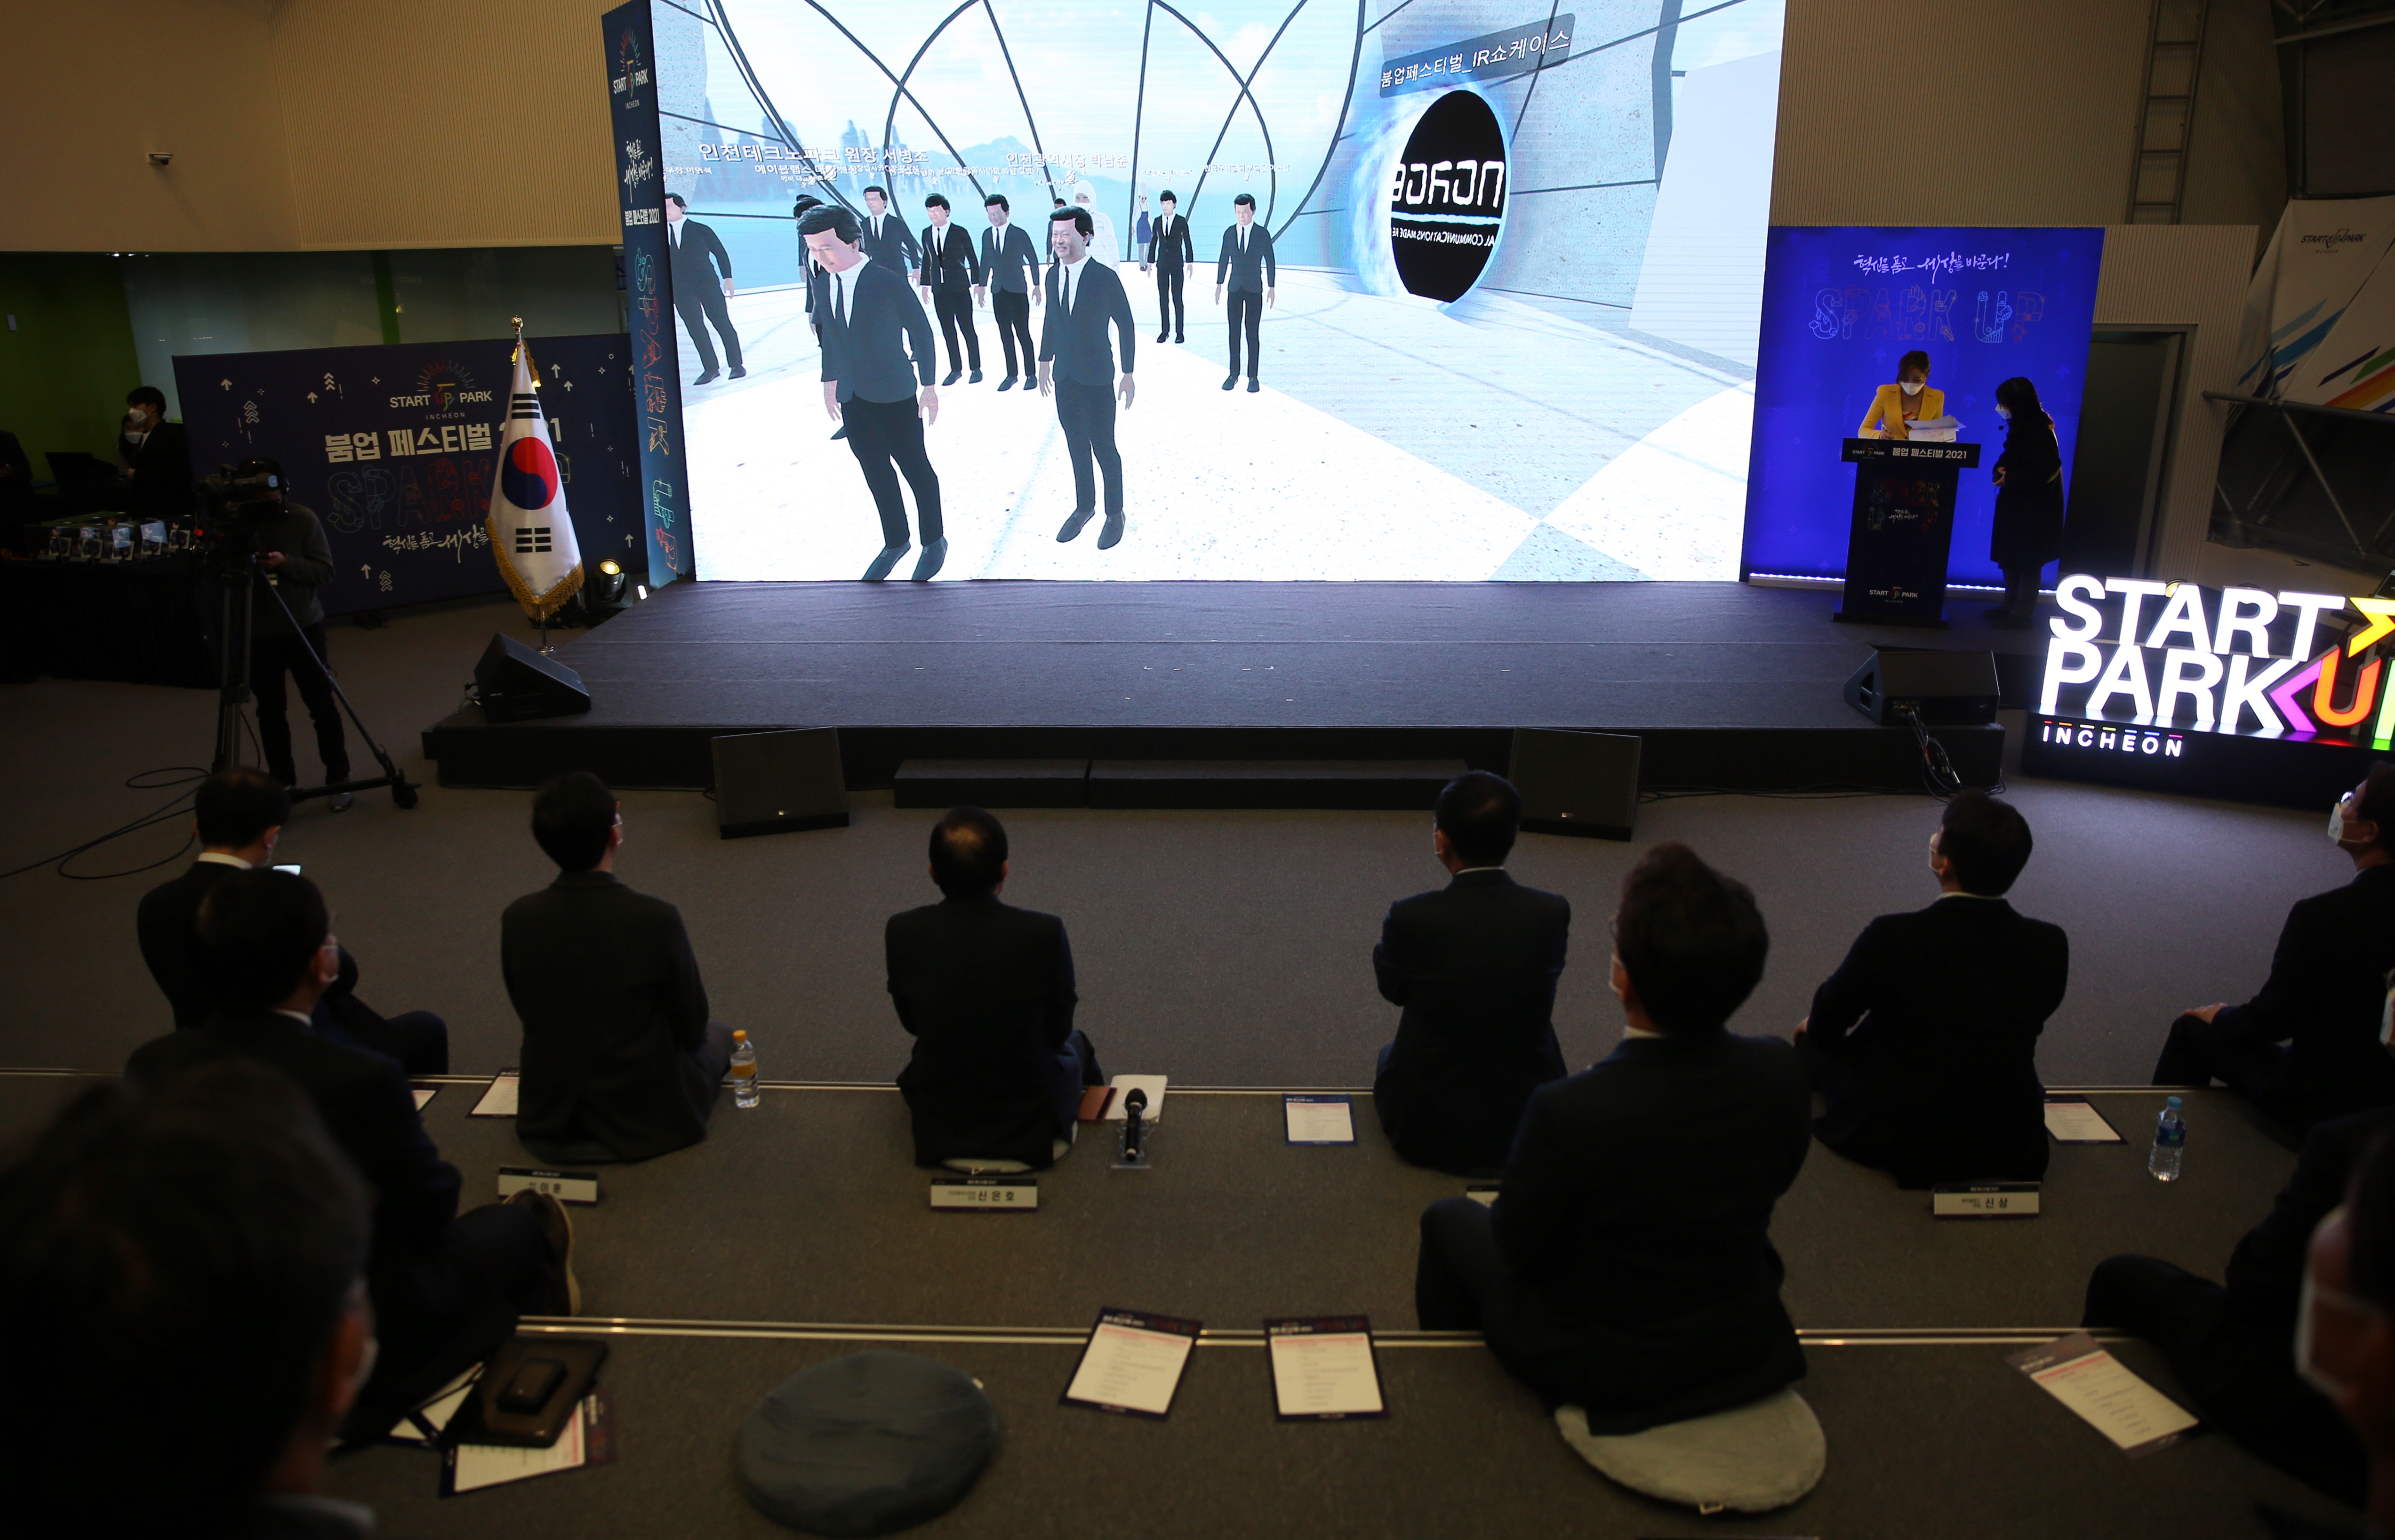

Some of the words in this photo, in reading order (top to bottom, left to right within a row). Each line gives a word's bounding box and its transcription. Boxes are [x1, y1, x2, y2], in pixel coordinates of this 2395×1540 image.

[1380, 30, 1570, 88] 붐업페스티벌_IR쇼케이스
[613, 76, 627, 94] START
[635, 68, 649, 86] PARK
[698, 143, 840, 163] 인천테크노파크
[845, 147, 877, 163] 원장
[883, 148, 929, 164] 서병조
[1006, 153, 1088, 168] 인천광역시장
[1090, 153, 1128, 168] 박남춘
[649, 208, 660, 224] 2021
[2300, 235, 2328, 243] START
[2343, 233, 2366, 242] PARK
[1853, 254, 1890, 276] 혁신을
[1890, 256, 1915, 275] 품고
[1917, 251, 1963, 284] 세상을
[1965, 253, 2011, 271] 바꾼다!
[1808, 285, 1957, 342] SPARK
[1975, 290, 2046, 343] UP
[390, 394, 431, 408] START
[459, 391, 493, 403] PARK
[325, 432, 381, 463] 붐업
[387, 423, 492, 457] 페스티벌
[1892, 447, 1909, 457] 붐업
[1911, 448, 1944, 458] 페스티벌
[1945, 449, 1967, 459] 2021
[2048, 573, 2346, 662] START
[2040, 636, 2300, 730] PARK
[2042, 725, 2183, 757] INCHEON
